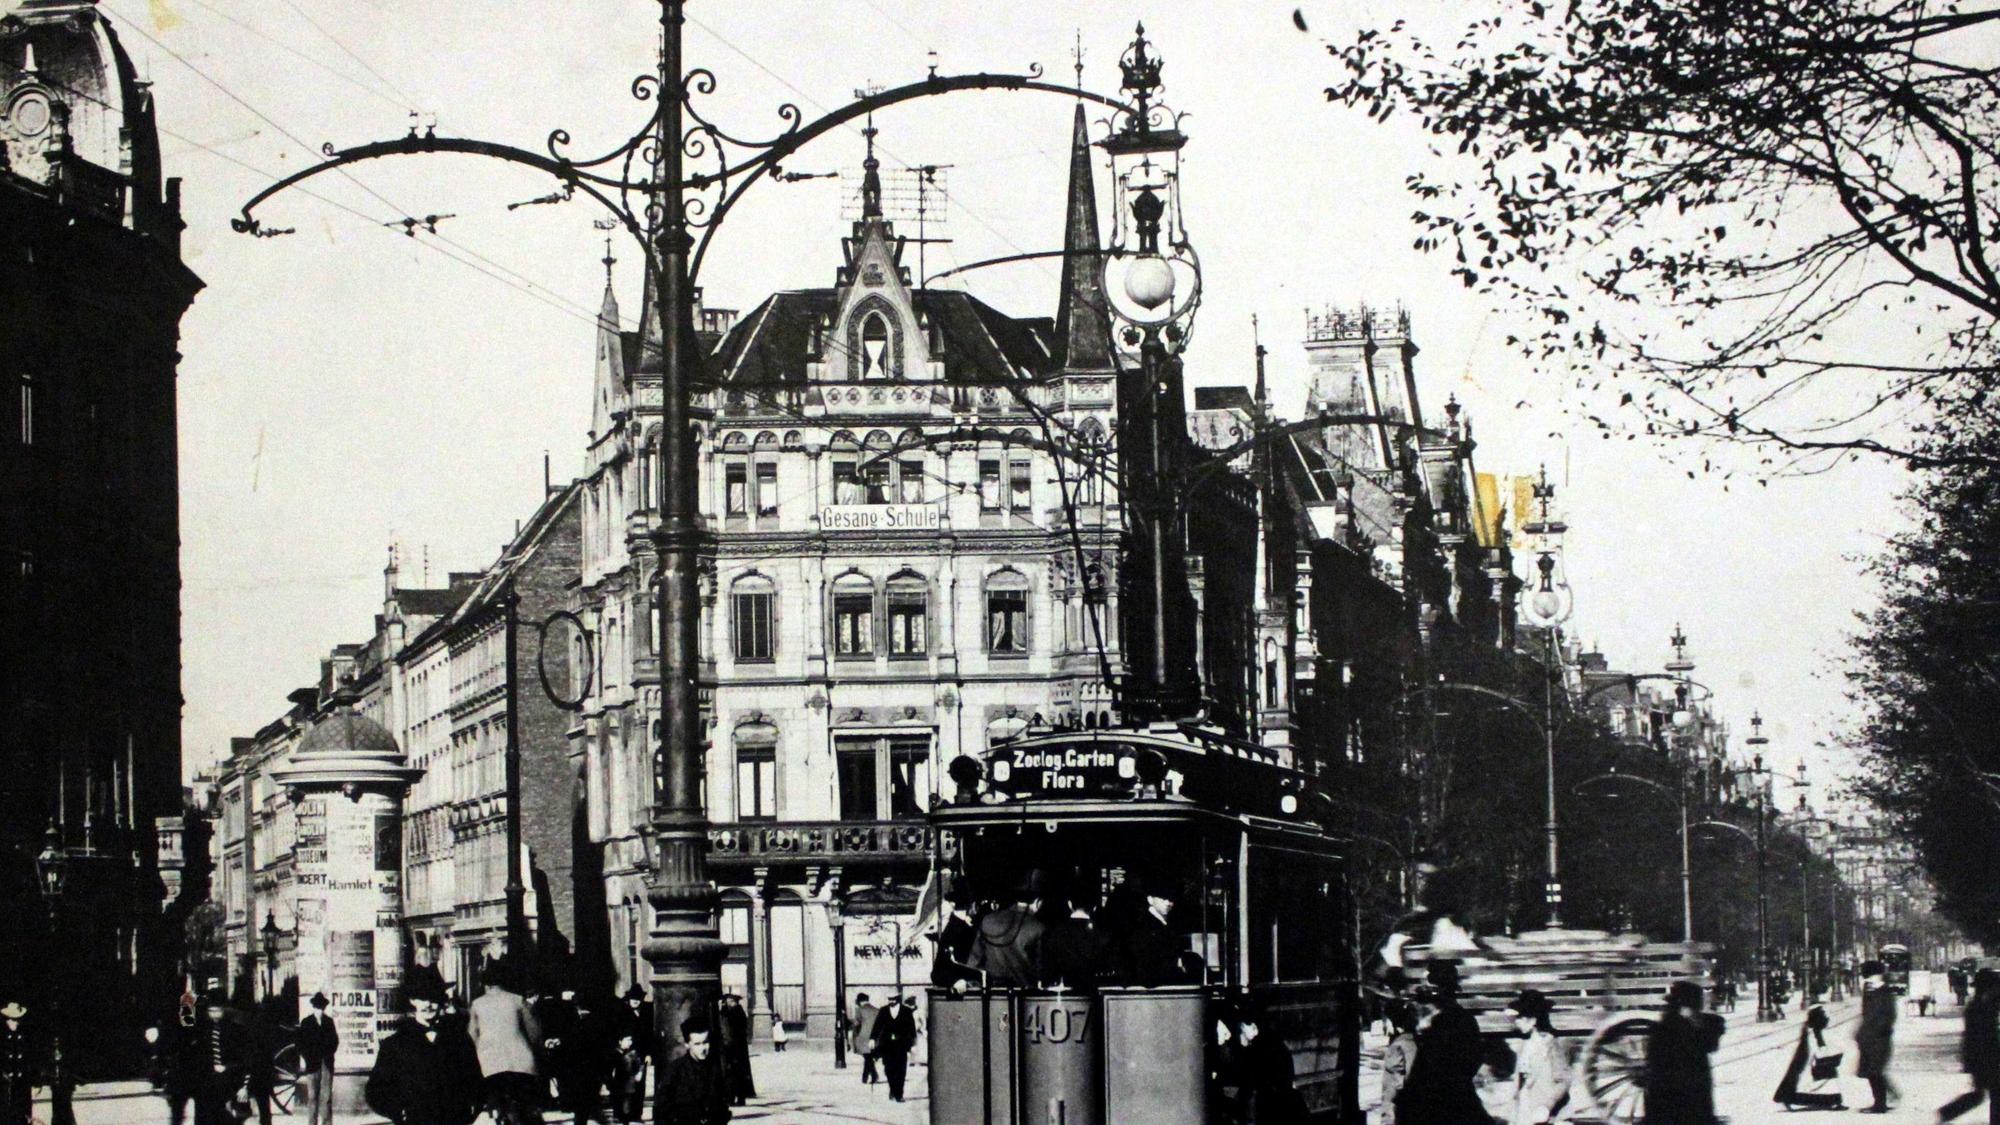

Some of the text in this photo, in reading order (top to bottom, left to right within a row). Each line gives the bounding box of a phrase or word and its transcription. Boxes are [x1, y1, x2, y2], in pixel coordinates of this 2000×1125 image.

[1042, 771, 1085, 789] Flora
[328, 880, 373, 890] Hamlet
[1024, 1005, 1092, 1044] 407
